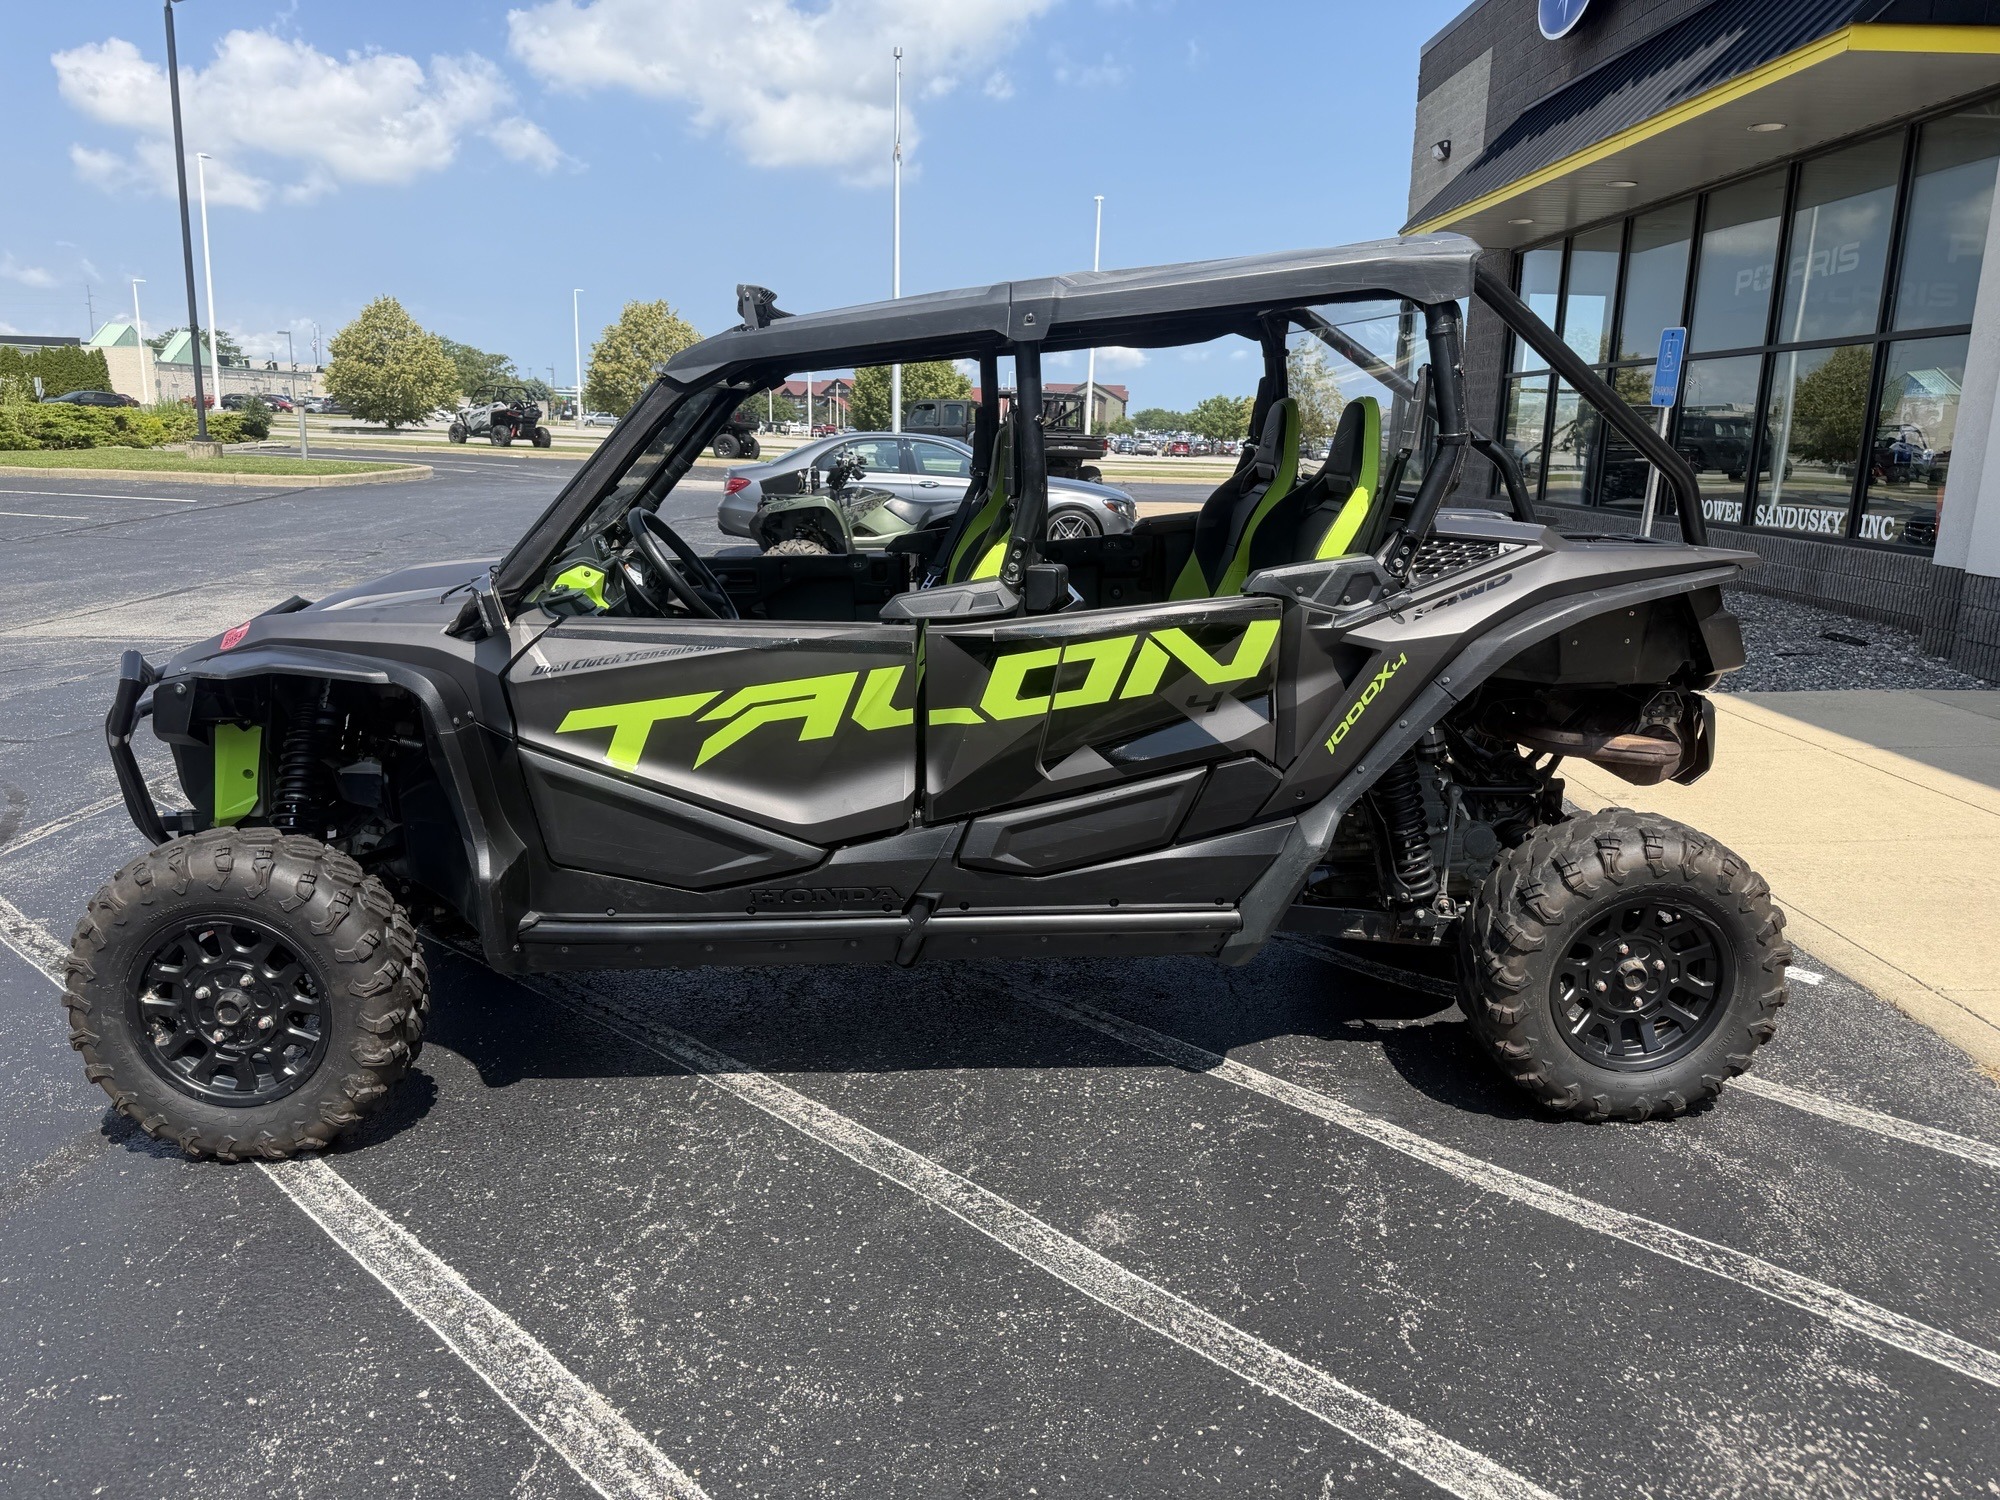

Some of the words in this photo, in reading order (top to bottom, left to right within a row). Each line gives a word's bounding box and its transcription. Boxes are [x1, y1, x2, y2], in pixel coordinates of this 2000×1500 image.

[1734, 241, 1861, 297] POARIS
[1654, 385, 1675, 397] PARKING
[1701, 499, 1742, 523] OWER
[1755, 504, 1846, 534] SANDUSKY
[1859, 513, 1895, 541] INC
[531, 661, 570, 676] Dual
[572, 655, 622, 670] Clutch
[556, 620, 1281, 772] TALON
[750, 887, 905, 903] HONDA
